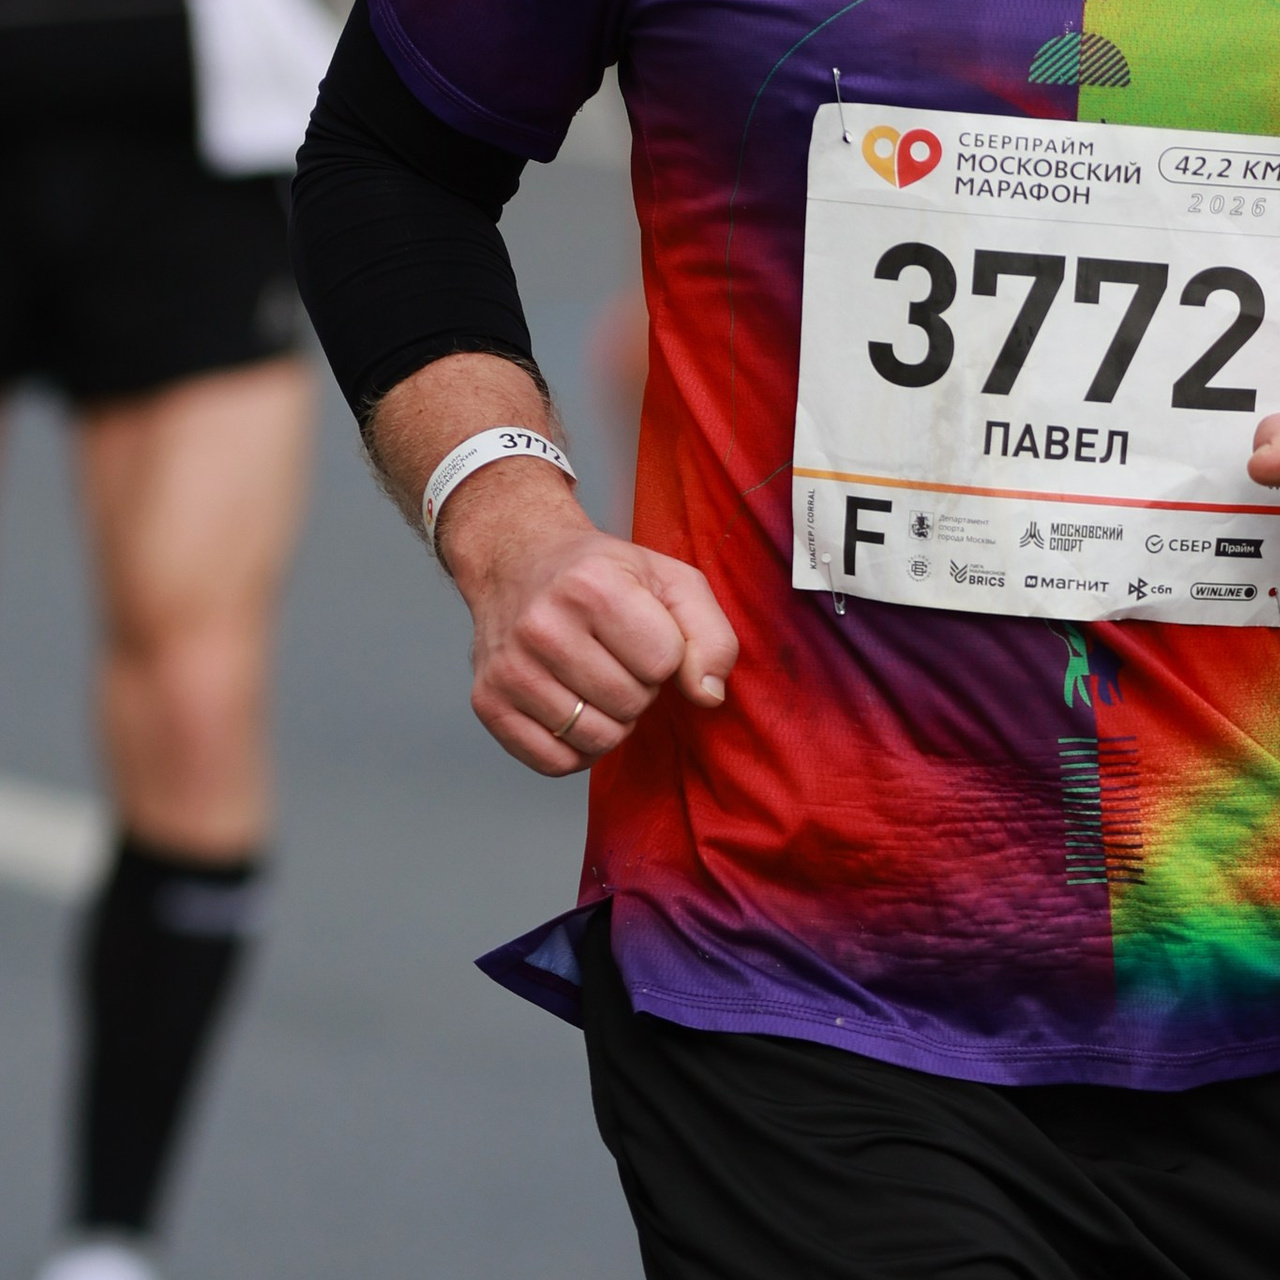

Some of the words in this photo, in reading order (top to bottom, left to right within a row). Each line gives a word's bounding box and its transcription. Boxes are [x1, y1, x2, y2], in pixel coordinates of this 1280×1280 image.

[958, 132, 1095, 157] СБЕРПРАЙМ
[956, 152, 1142, 185] МОСКОВСКИЙ
[1174, 155, 1232, 180] 42,2
[954, 176, 1092, 205] МАРАФОН
[1187, 192, 1267, 217] 2026
[867, 241, 1266, 413] 3772
[498, 433, 566, 467] 3772
[982, 420, 1129, 465] ПАВЕЛ
[808, 488, 816, 523] CORRAL
[938, 514, 989, 526] Департамент
[1050, 522, 1124, 541] МОСКОВСКИЙ
[843, 495, 893, 577] F
[937, 533, 965, 542] города
[1049, 537, 1084, 552] СПОРТ
[1168, 538, 1212, 553] СБЕР
[1219, 542, 1255, 555] Прайм
[809, 530, 818, 570] КЛАСТЕР
[968, 574, 1005, 588] BRICS
[1040, 576, 1110, 593] магнит
[1150, 584, 1173, 595] сбп
[1195, 586, 1243, 598] WINLINE
